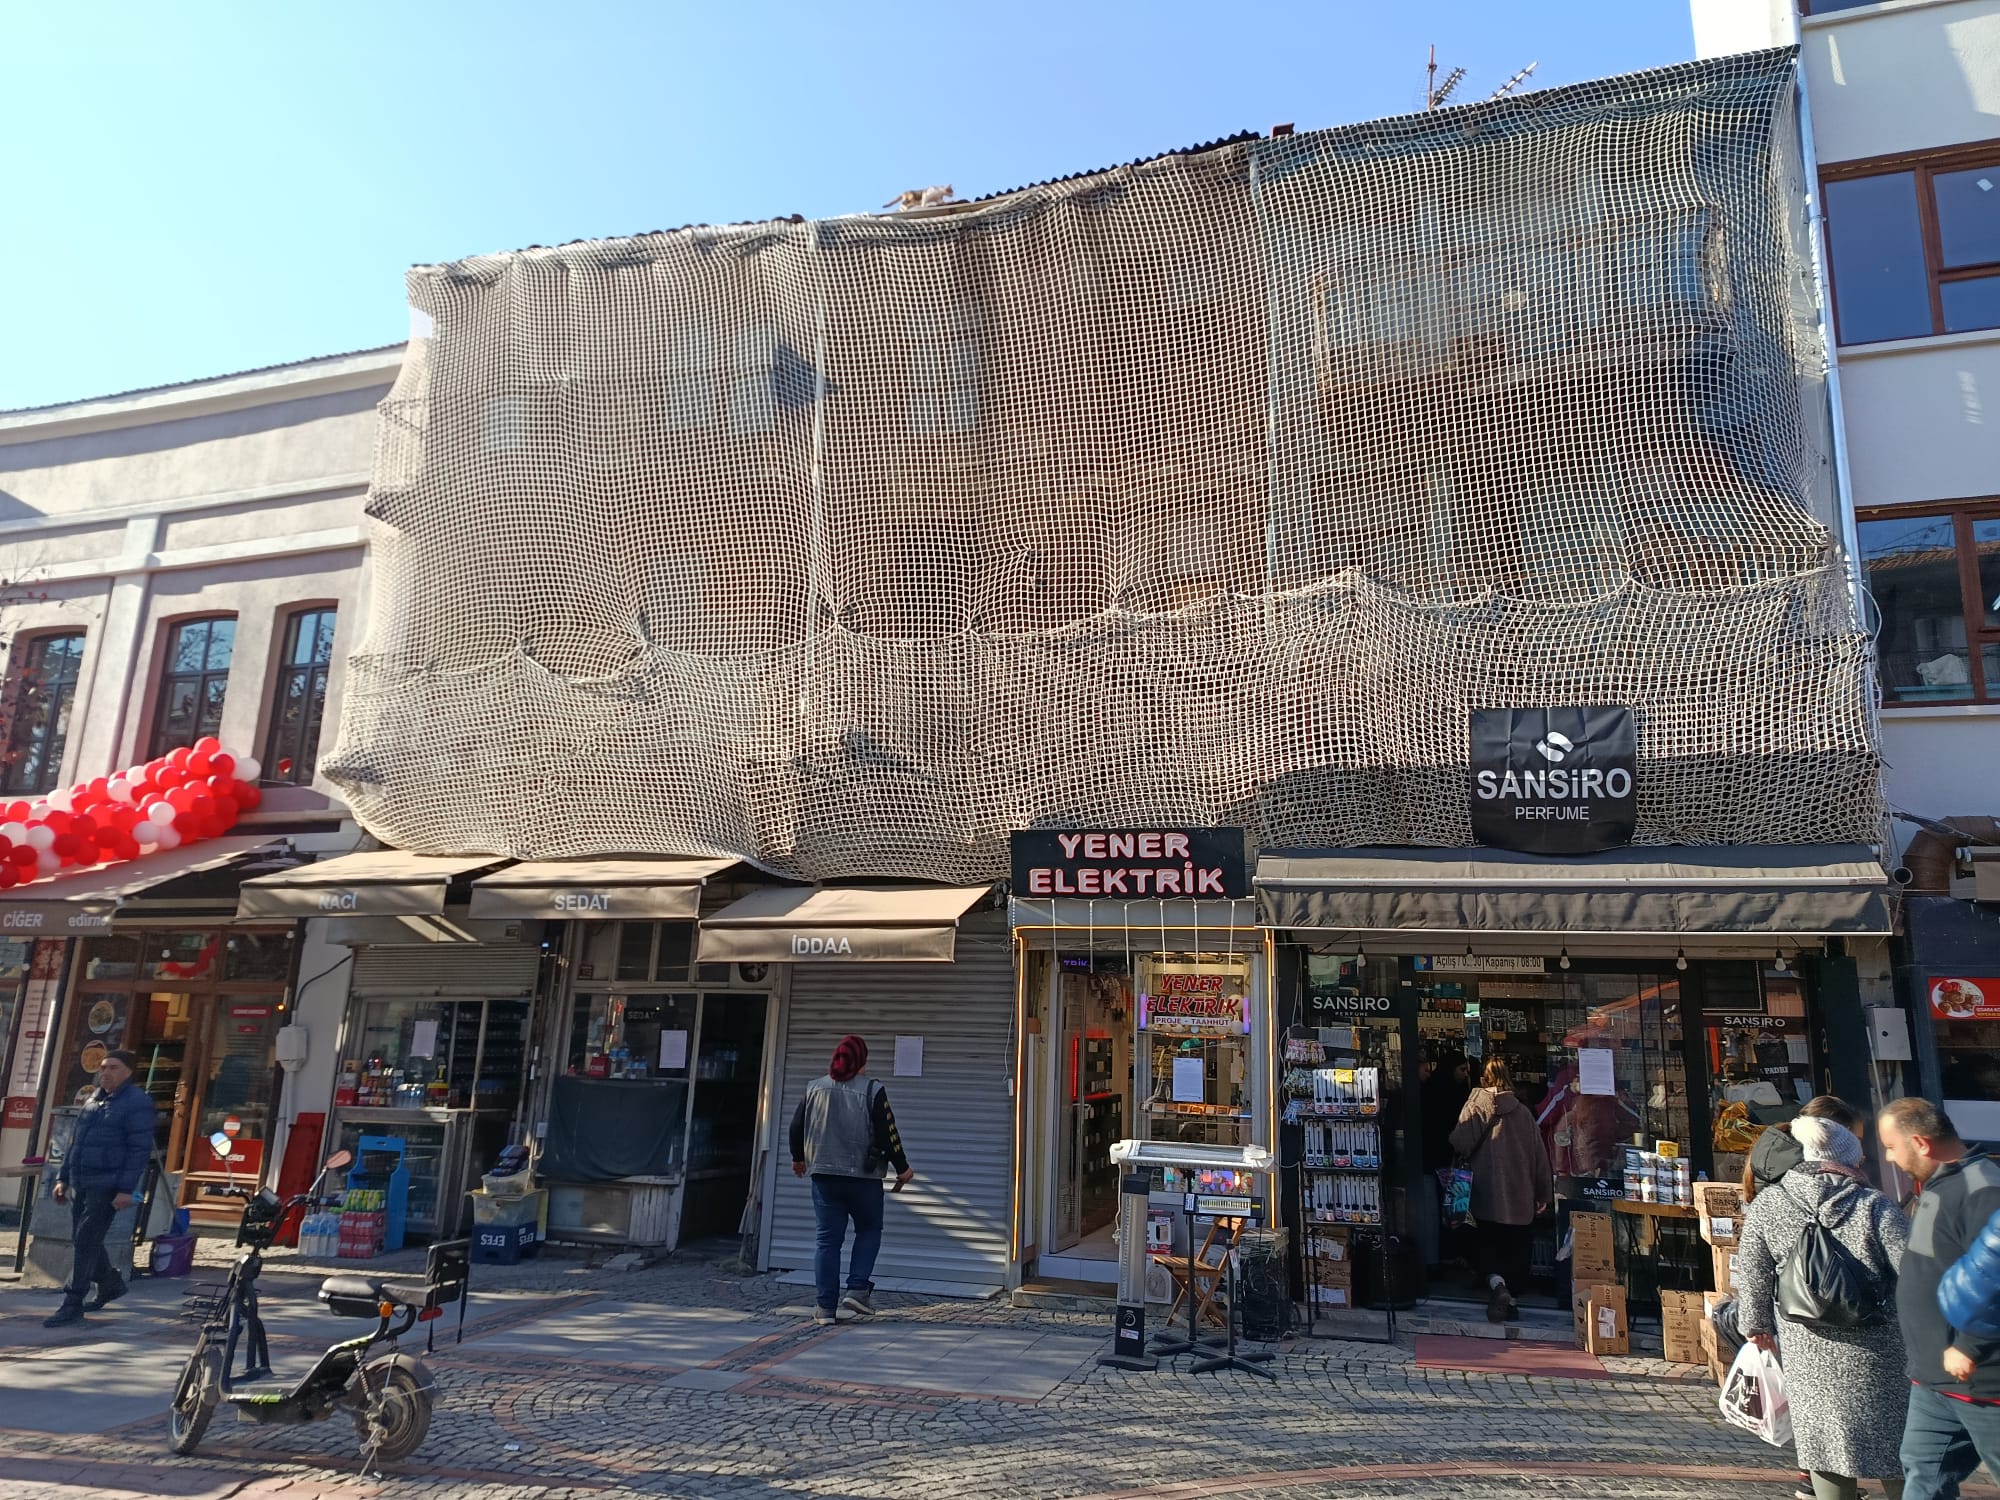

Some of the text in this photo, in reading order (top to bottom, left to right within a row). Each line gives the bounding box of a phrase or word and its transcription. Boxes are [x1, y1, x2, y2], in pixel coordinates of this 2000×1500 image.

[1515, 806, 1590, 820] PERFUME
[1058, 833, 1190, 859] YENER
[1029, 861, 1225, 894] ELEKTRİK
[318, 892, 358, 910] NACİ
[554, 894, 611, 911] SEDAT
[3, 910, 43, 927] CİĞER
[791, 934, 852, 954] İDDAA
[1485, 956, 1515, 970] Kapanış
[1162, 974, 1224, 993] YENER
[1146, 994, 1240, 1015] ELEKTRİK
[480, 1234, 506, 1247] EFES
